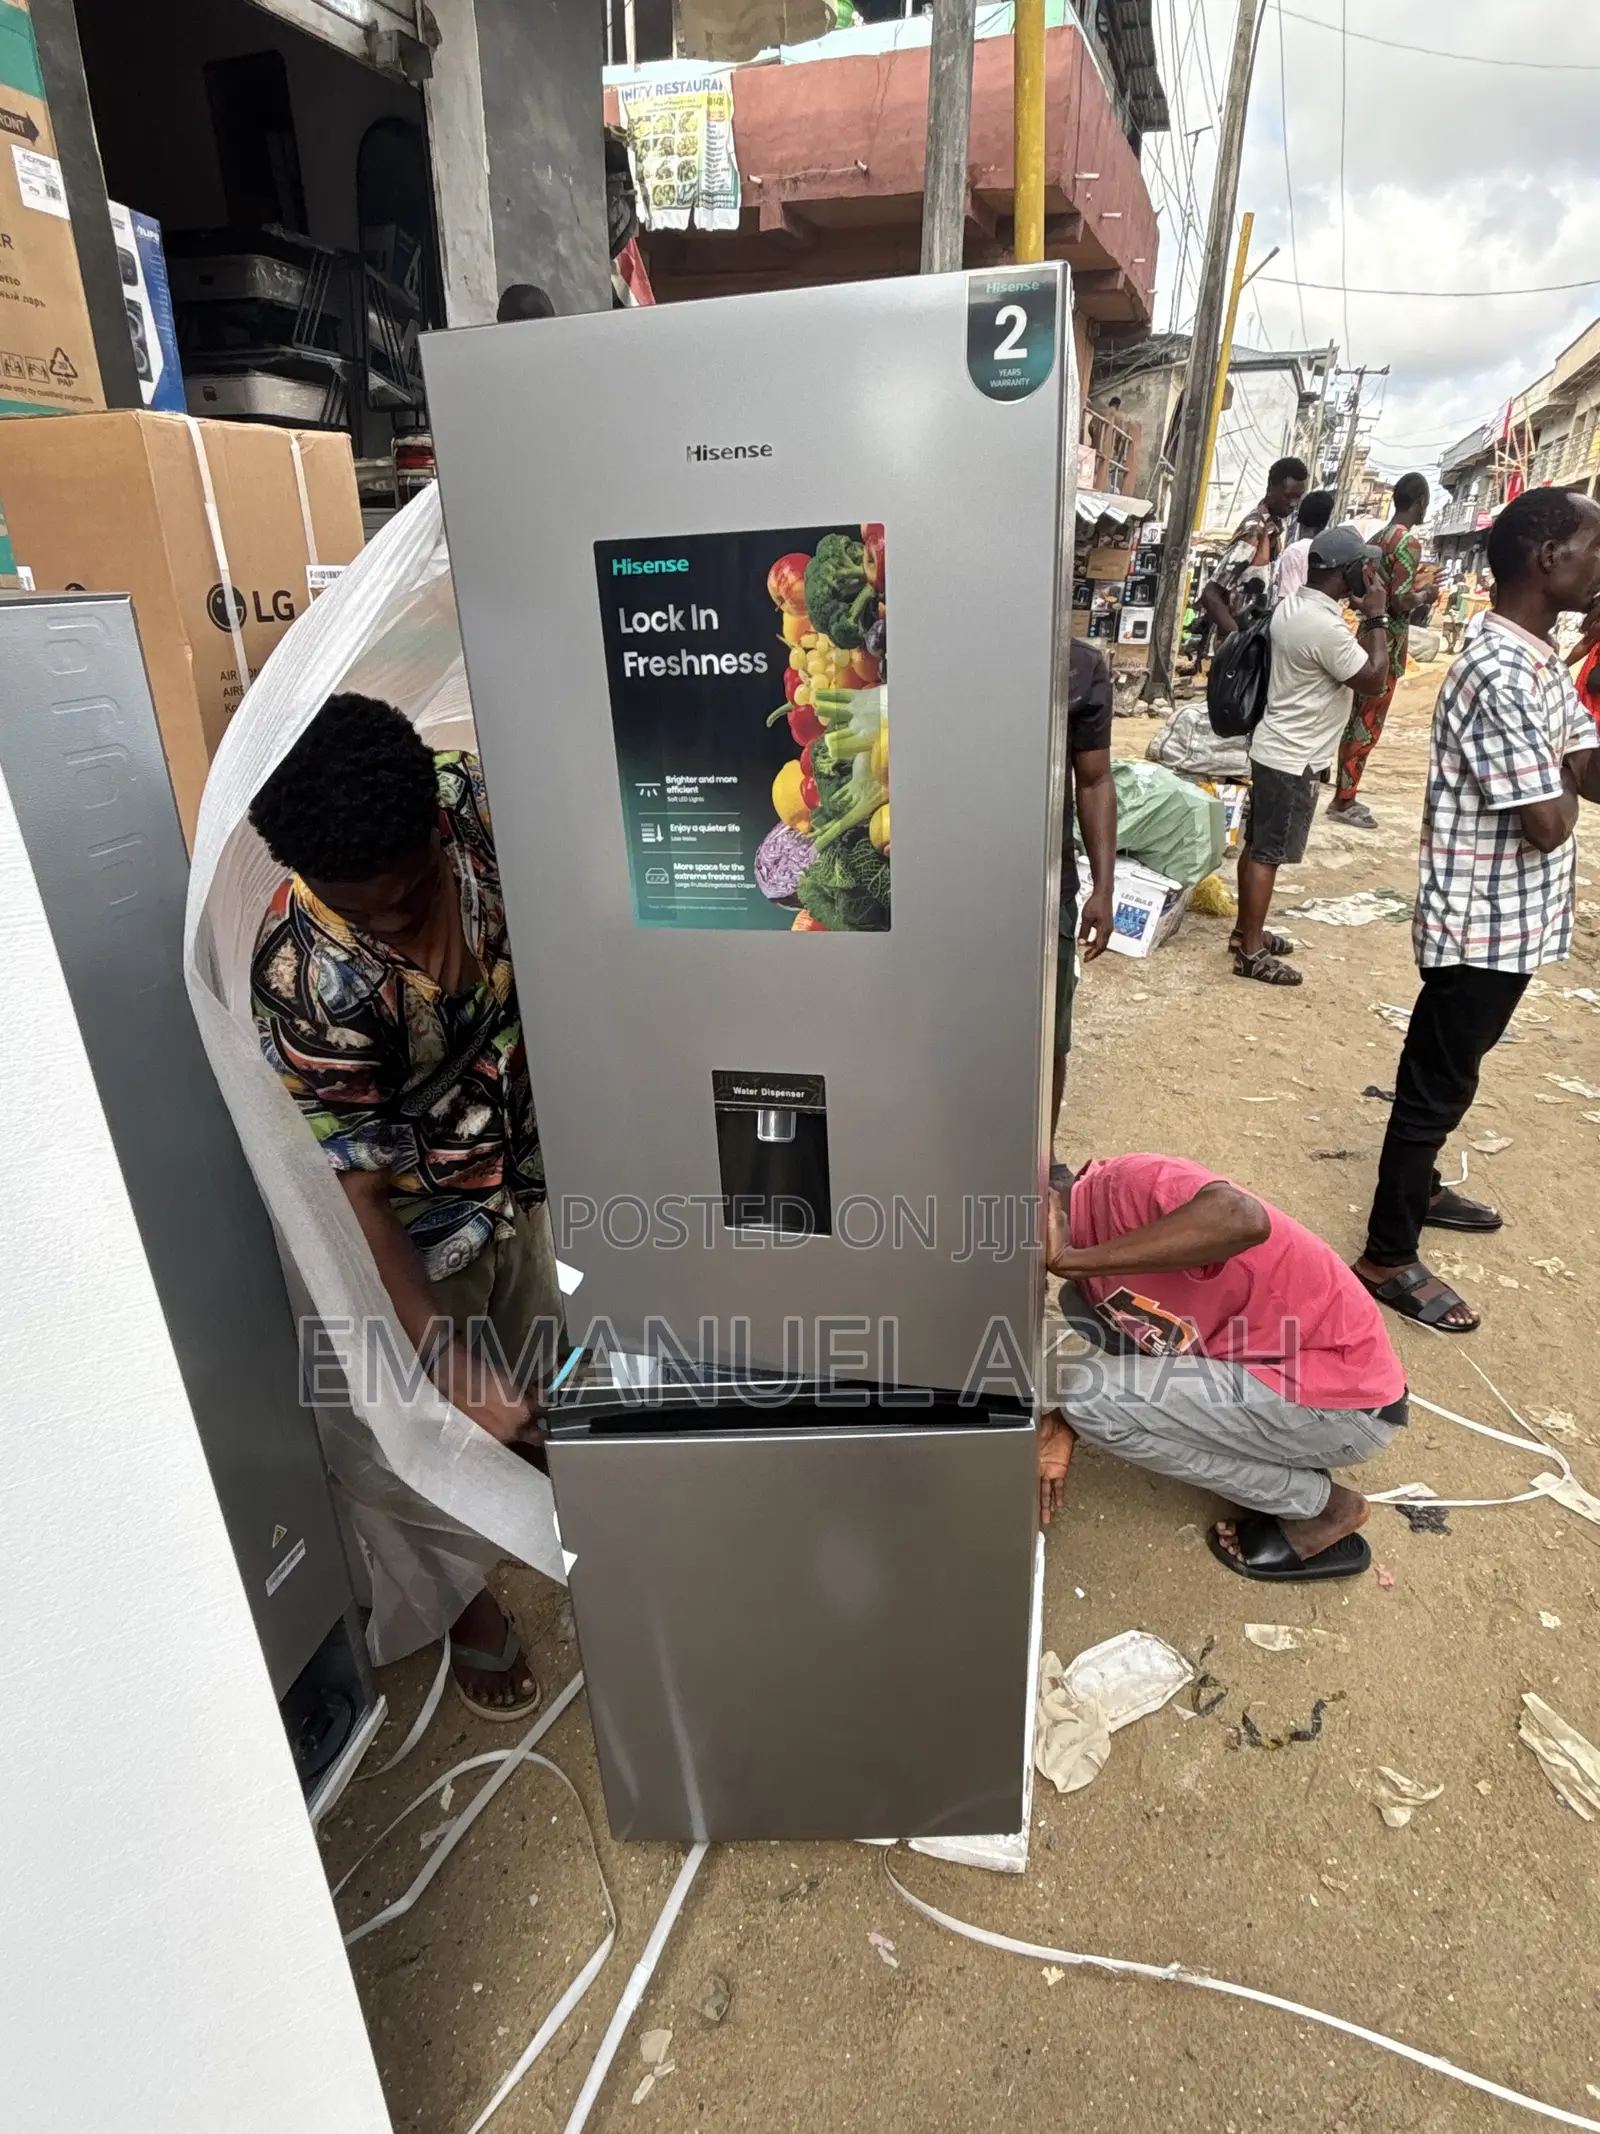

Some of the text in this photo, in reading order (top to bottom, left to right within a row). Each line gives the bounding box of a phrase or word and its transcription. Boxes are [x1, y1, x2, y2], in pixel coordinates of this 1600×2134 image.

[985, 281, 1040, 294] Hisense
[993, 304, 1028, 361] 2
[998, 368, 1022, 377] YEARS
[990, 378, 1030, 388] WARRANTY
[686, 444, 773, 462] Hisense
[612, 558, 690, 576] Hisense
[252, 590, 295, 622] LG
[618, 603, 719, 634] Lock In
[623, 648, 769, 678] Freshness
[220, 669, 237, 681] AIR
[665, 775, 739, 785] Brighter and more
[666, 785, 700, 794] efficient
[670, 823, 691, 834] Enjoy
[698, 823, 726, 834] quieter
[727, 823, 740, 832] life
[673, 863, 745, 872] More space for the
[674, 872, 745, 881] extreme freshness
[1121, 892, 1135, 901] LED
[733, 1086, 806, 1098] Water Dispenser
